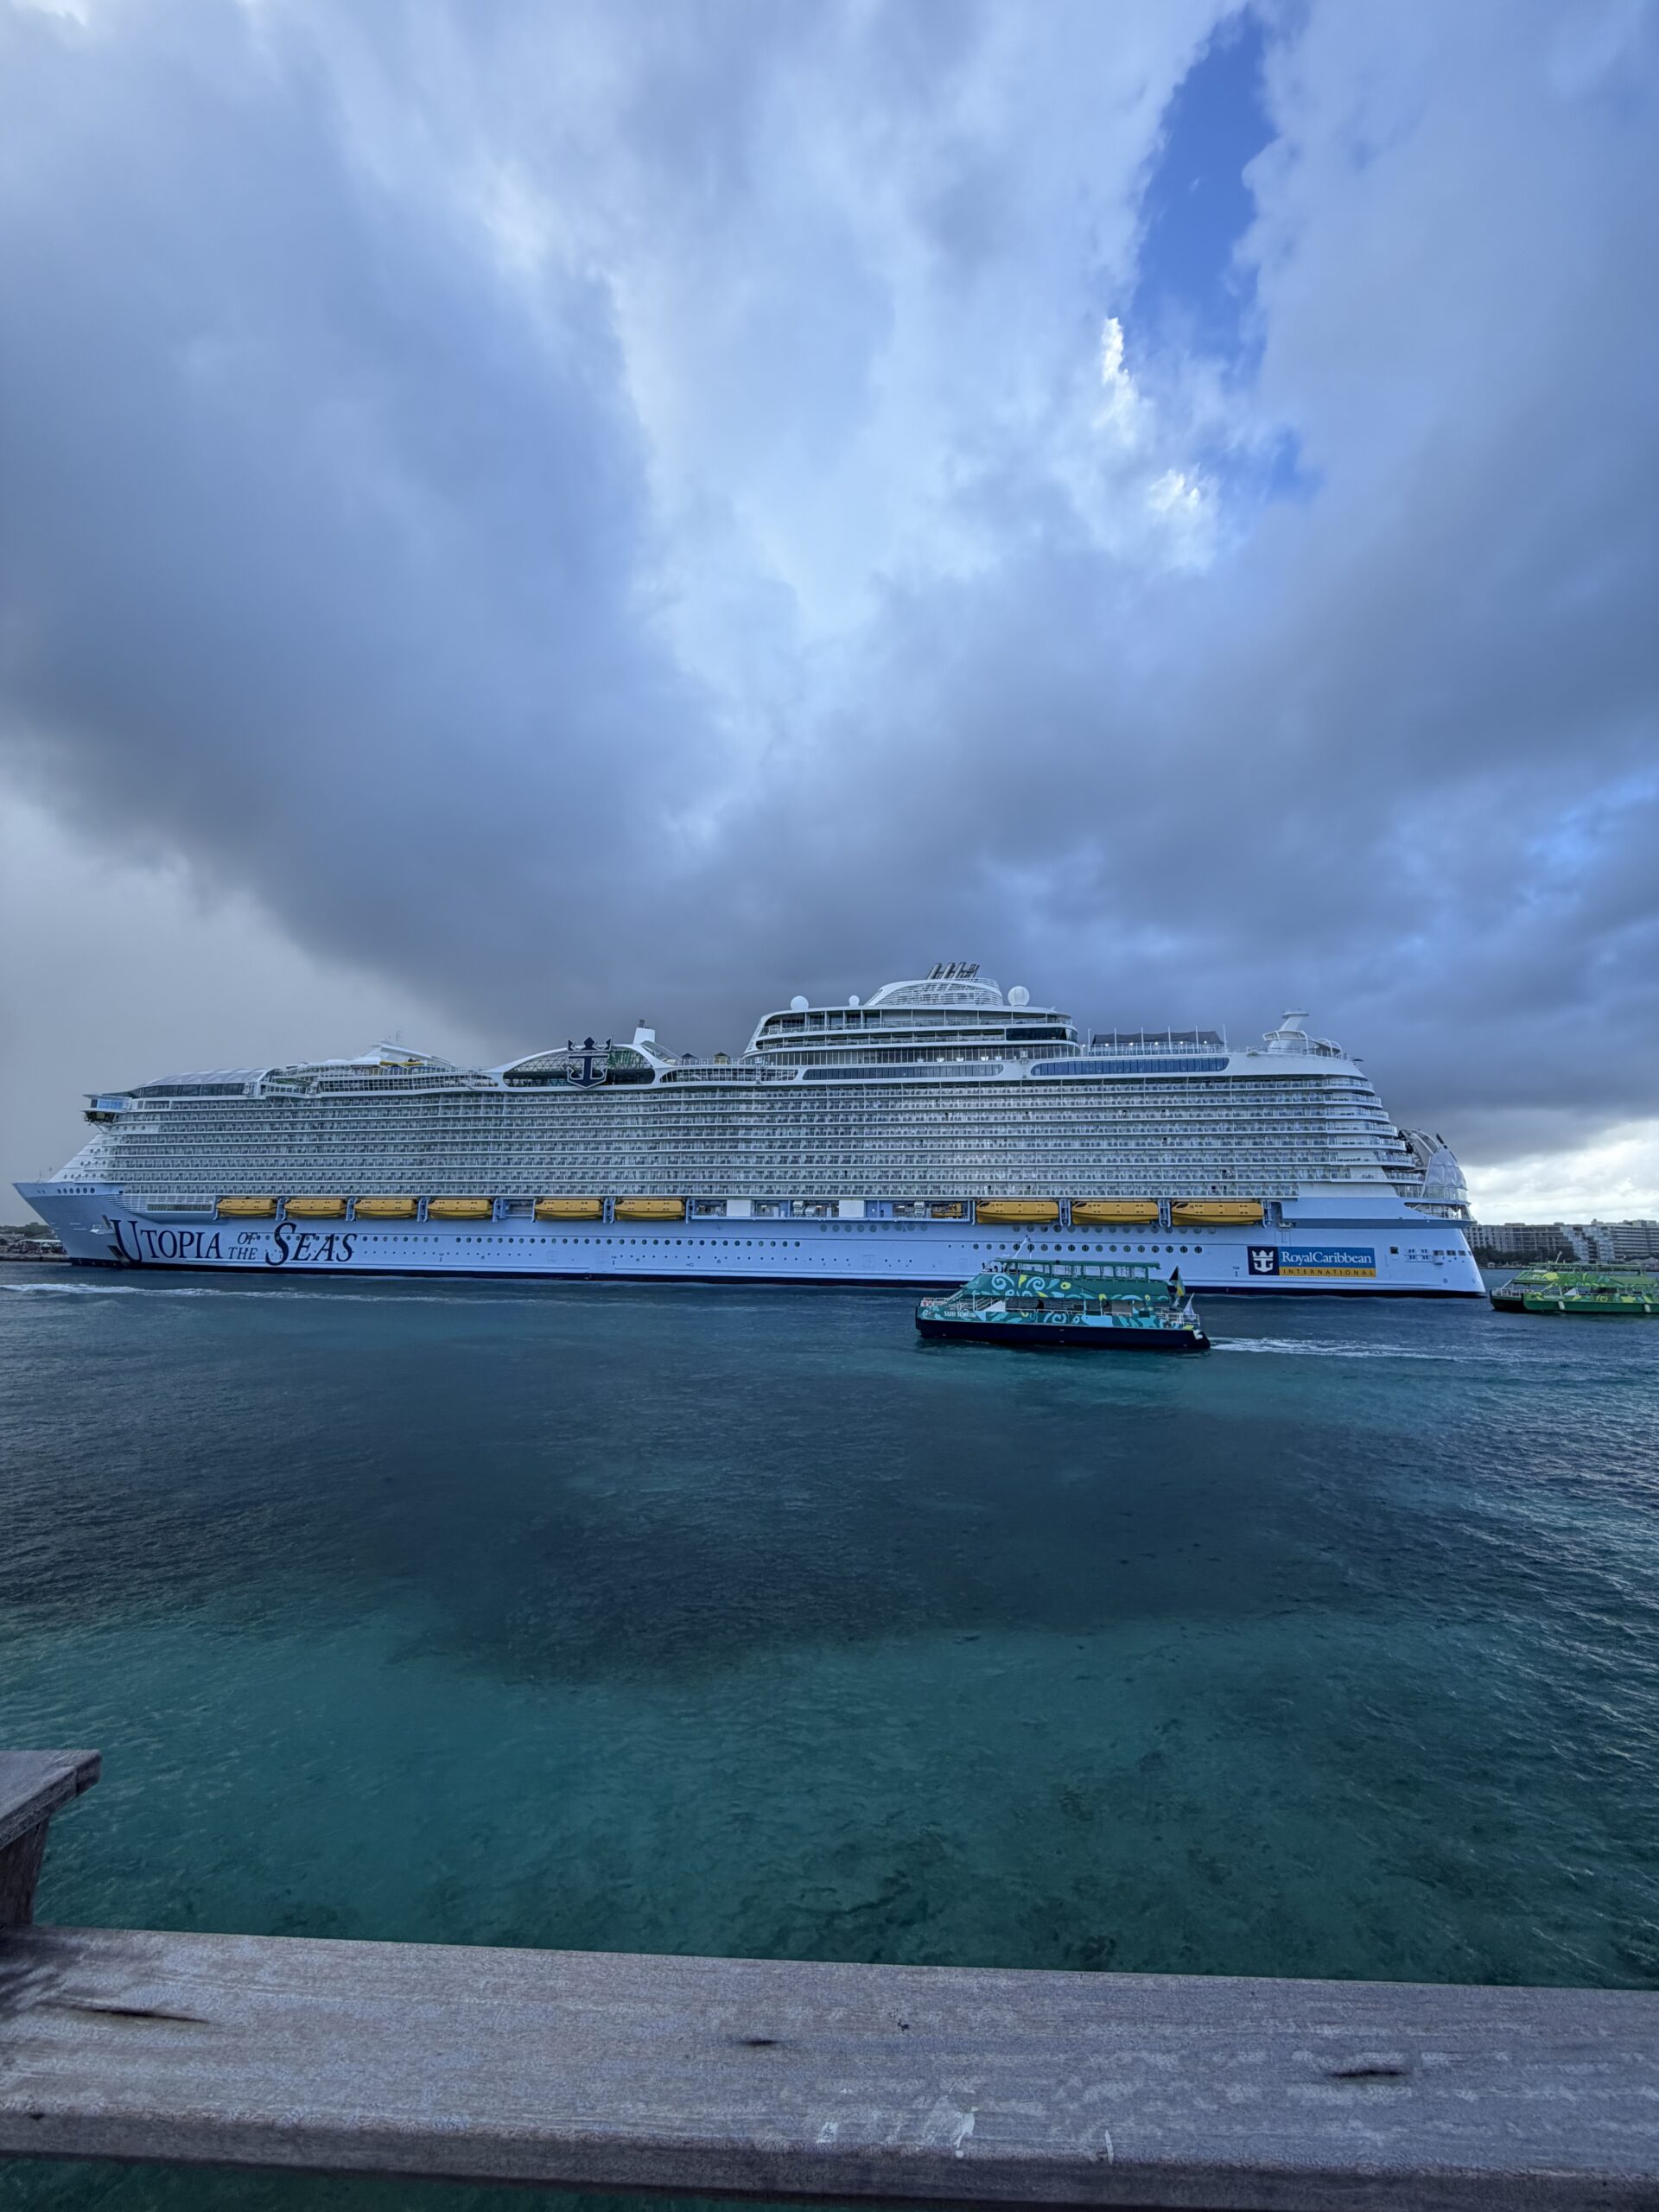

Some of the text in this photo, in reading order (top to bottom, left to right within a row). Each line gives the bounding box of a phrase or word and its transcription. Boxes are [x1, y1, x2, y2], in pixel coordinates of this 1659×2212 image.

[110, 1219, 358, 1266] UTOPIA OF THE SEAS
